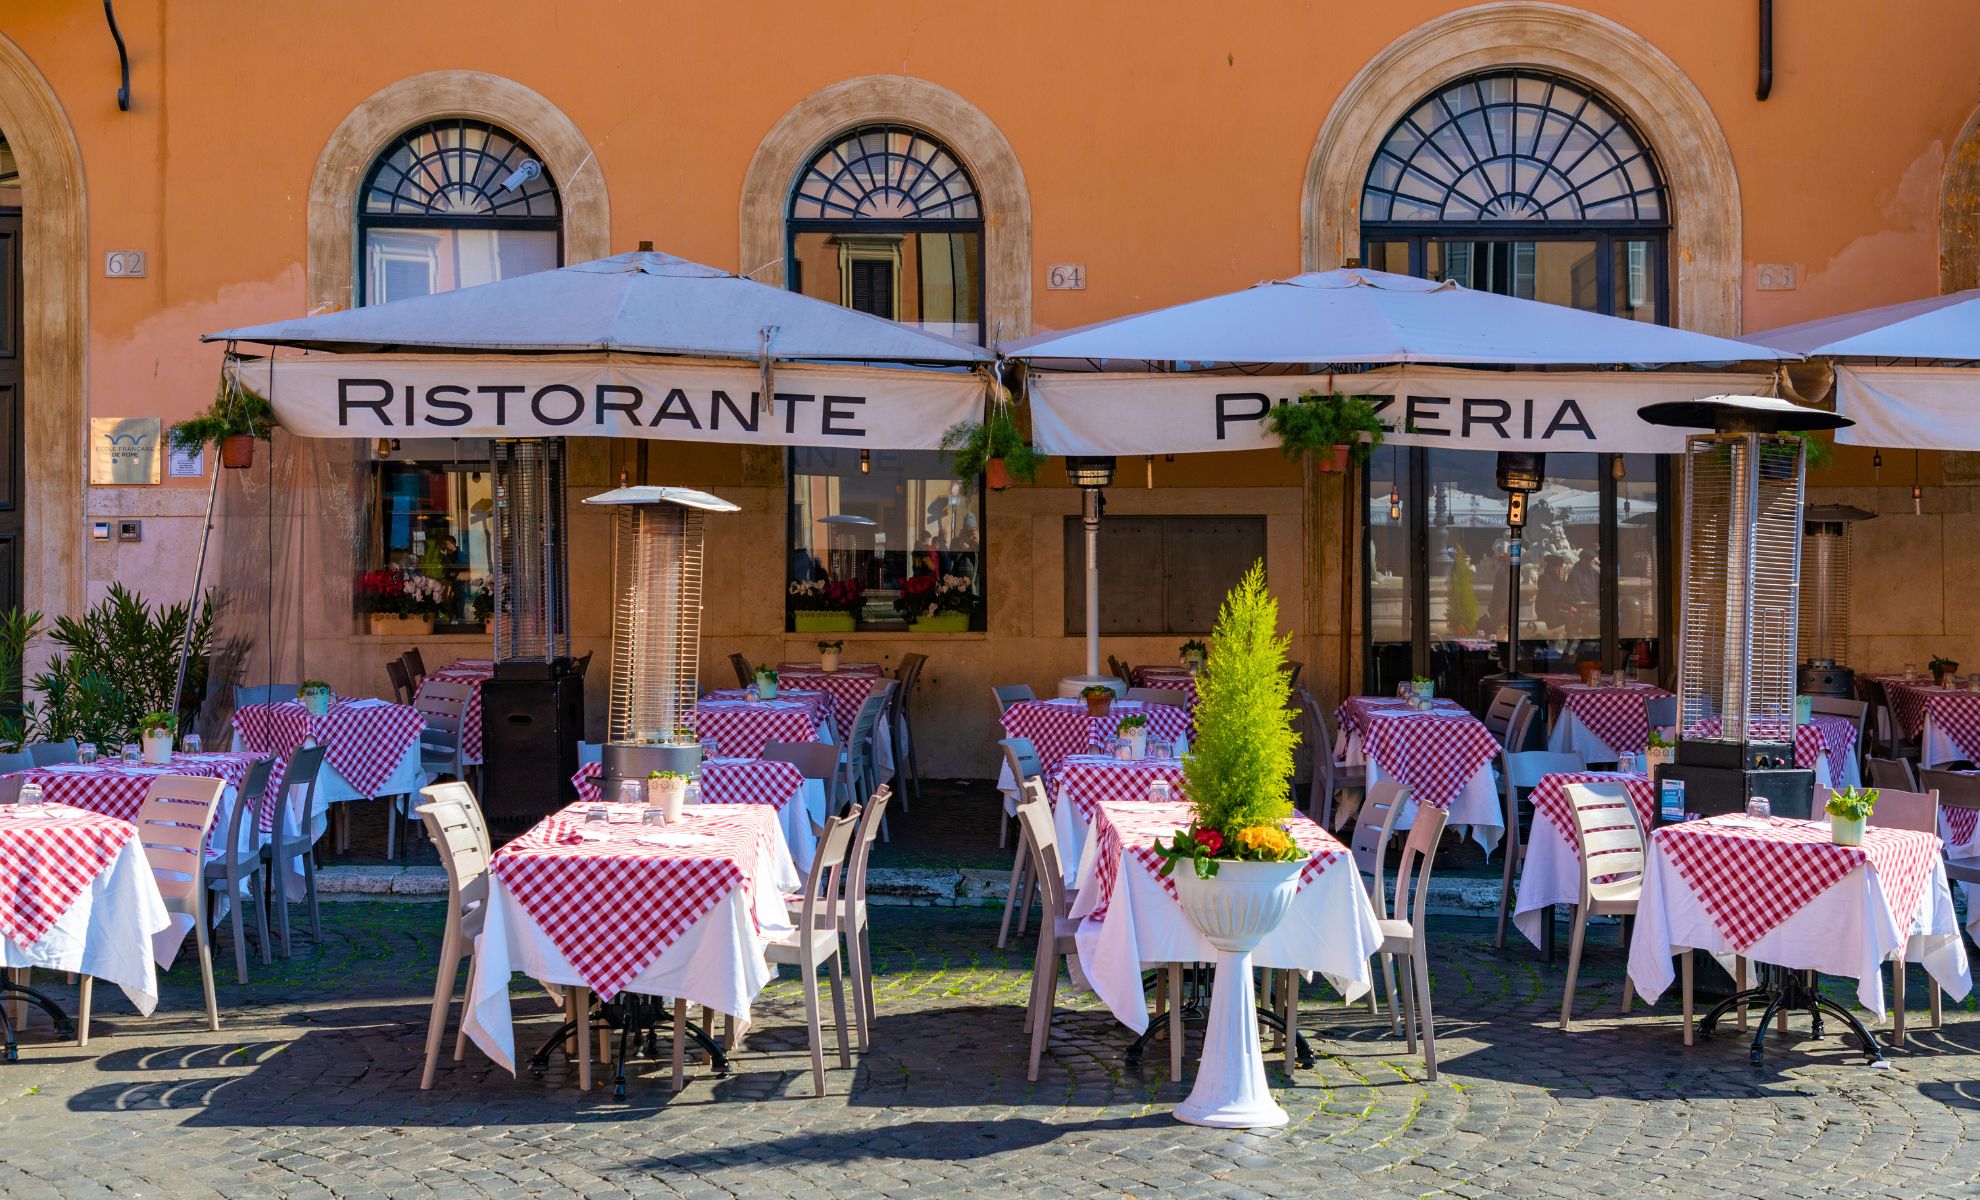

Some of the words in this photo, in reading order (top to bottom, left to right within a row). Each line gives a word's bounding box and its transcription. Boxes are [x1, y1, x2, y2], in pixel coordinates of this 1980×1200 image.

[109, 253, 141, 274] 62
[1051, 266, 1082, 287] 64
[338, 378, 867, 437] RISTORANTE
[1215, 392, 1598, 440] PZERIA
